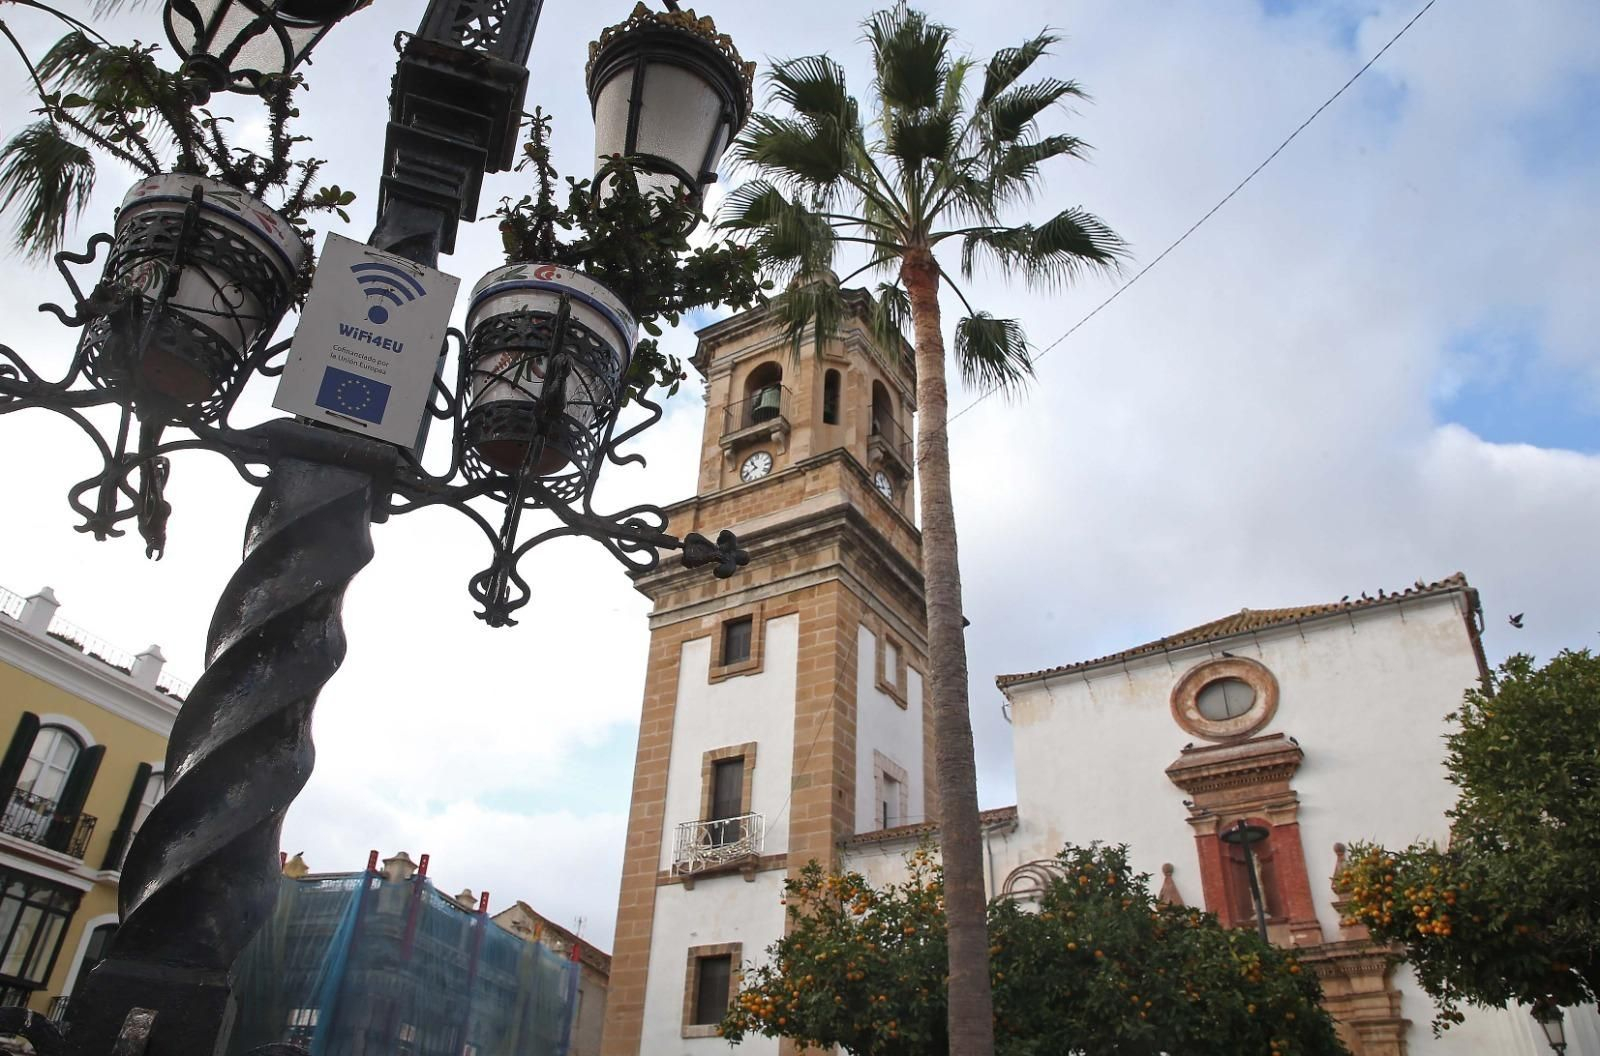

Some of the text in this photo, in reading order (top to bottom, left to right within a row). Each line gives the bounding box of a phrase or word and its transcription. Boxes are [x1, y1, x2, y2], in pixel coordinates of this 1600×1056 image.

[339, 323, 404, 353] WiFi4EU
[330, 352, 386, 375] la Unión Europea
[332, 344, 389, 368] Cofinanciado por
